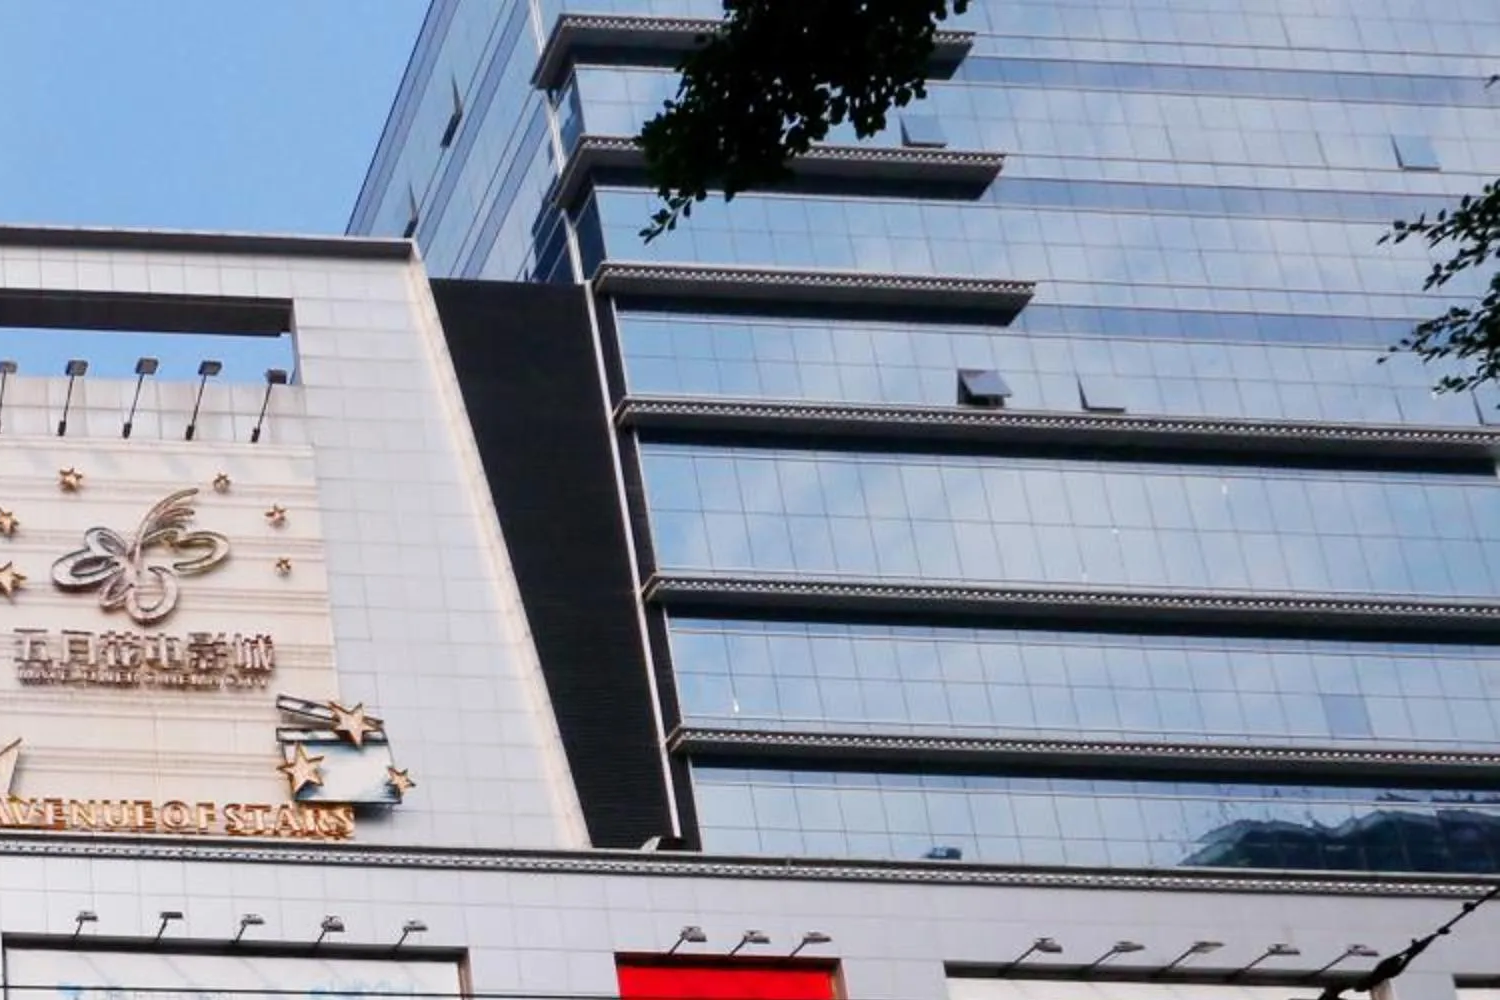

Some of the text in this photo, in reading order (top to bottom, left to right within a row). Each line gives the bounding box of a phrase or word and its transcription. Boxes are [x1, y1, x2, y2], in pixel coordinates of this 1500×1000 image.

[12, 628, 276, 674] 五月花电影城
[157, 800, 217, 834] OF
[224, 802, 356, 840] STARS
